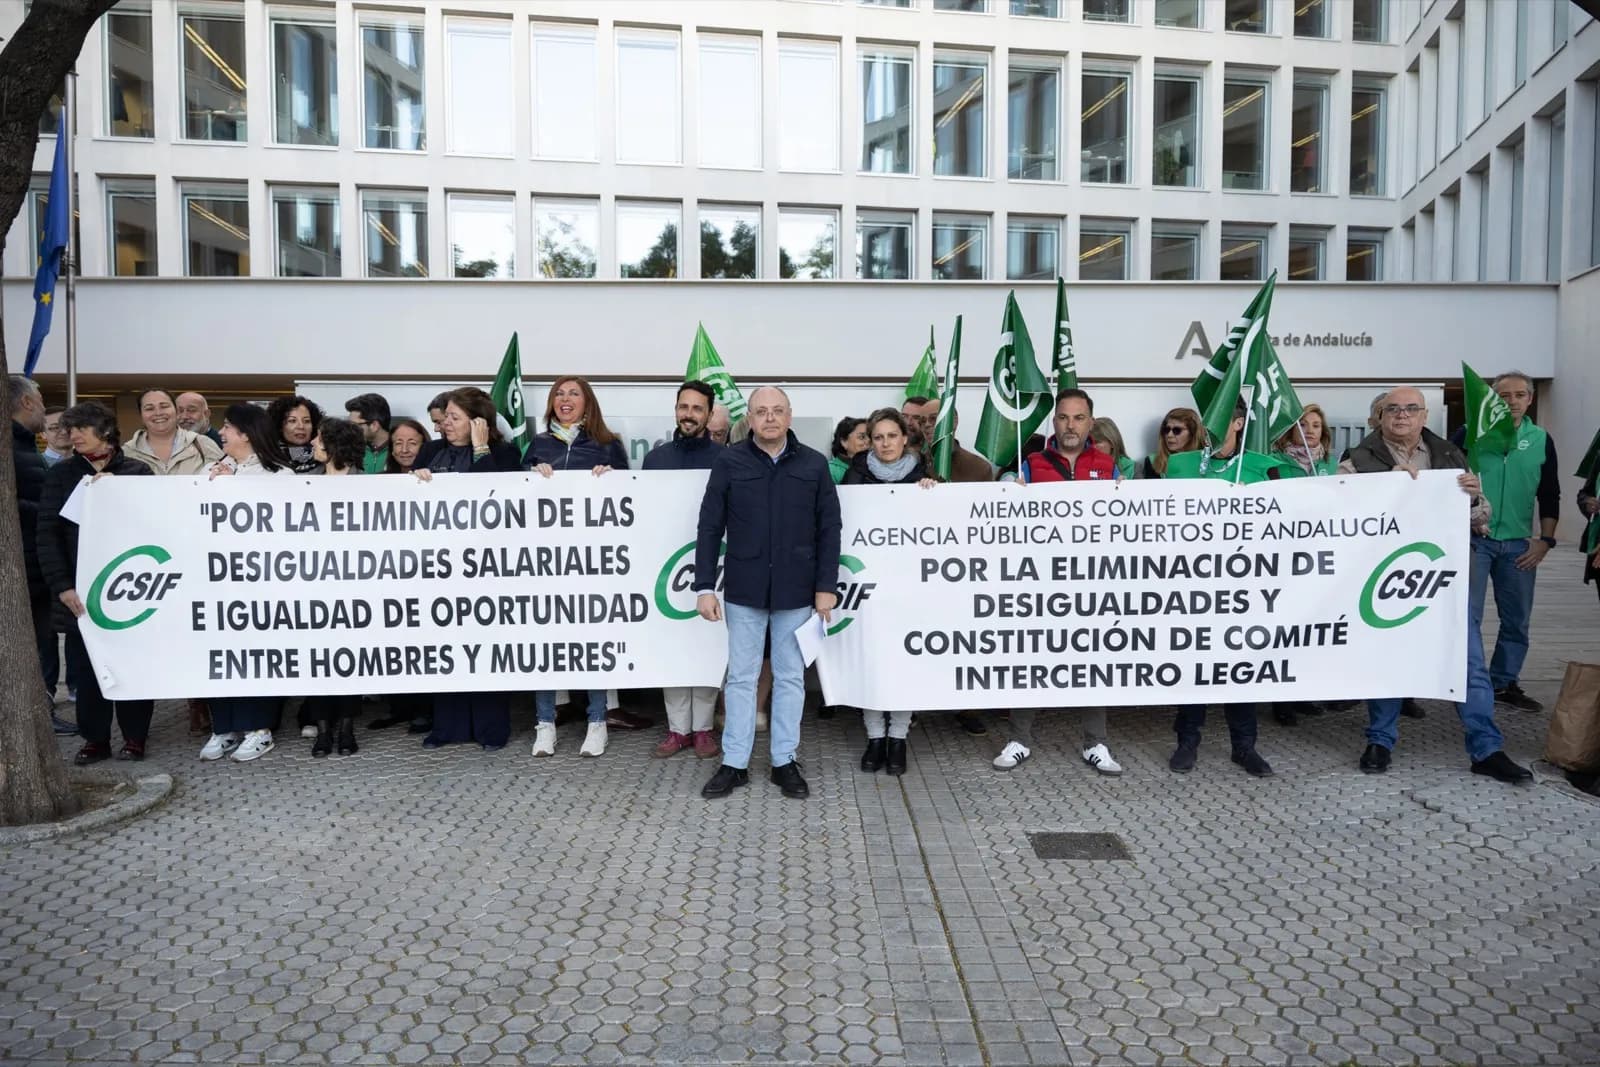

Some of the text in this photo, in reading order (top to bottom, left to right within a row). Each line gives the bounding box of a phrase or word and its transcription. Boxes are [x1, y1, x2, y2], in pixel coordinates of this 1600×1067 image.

[1282, 332, 1300, 346] de
[1303, 331, 1373, 346] Andalucía
[200, 489, 635, 533] "POR LA ELIMINACIÓN DE LAS
[969, 494, 1282, 519] MIEMBROS COMITÉ EMPRESA
[851, 512, 1401, 546] AGENCIA PÚBLICA DE PUERTOS DE ANDALUCÍA
[207, 548, 453, 582] DESIGUALDADES
[462, 544, 631, 579] SALARIALES
[920, 545, 1335, 583] POR LA ELIMINACIÓN DE
[106, 571, 183, 602] CSIF
[832, 582, 877, 611] SIF
[1377, 569, 1458, 600] CSIF
[191, 593, 649, 631] E IGUALDAD DE OPORTUNIDAD
[973, 588, 1281, 618] DESIGUALDADES Y
[903, 614, 1349, 656] CONSTITUCIÓN DE COMITÉ
[209, 641, 635, 680] ENTRE HOMBRES Y MUJERES".
[955, 659, 1297, 690] INTERCENTRO LEGAL
